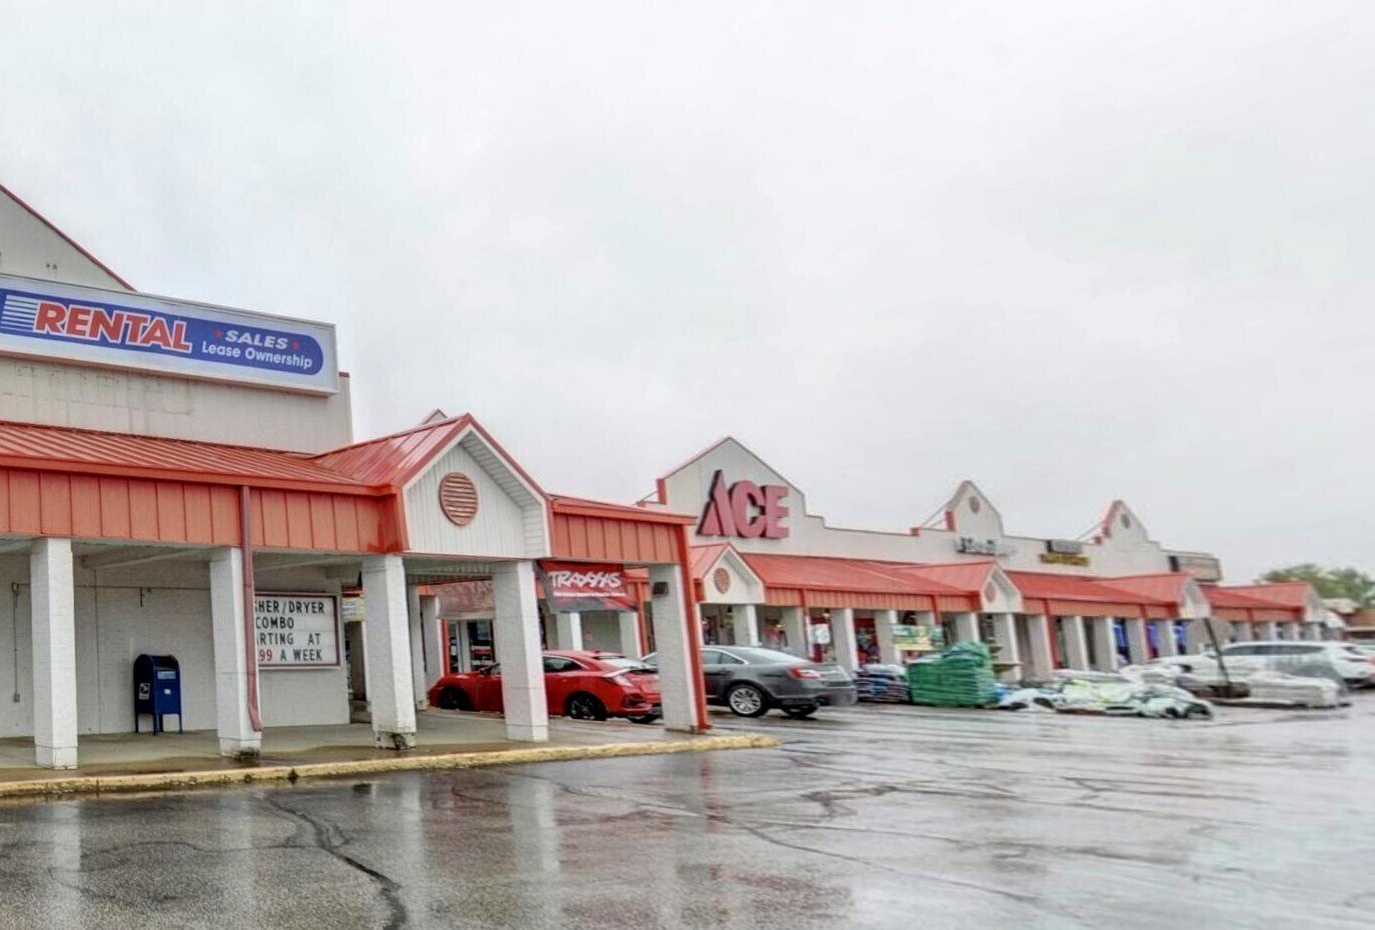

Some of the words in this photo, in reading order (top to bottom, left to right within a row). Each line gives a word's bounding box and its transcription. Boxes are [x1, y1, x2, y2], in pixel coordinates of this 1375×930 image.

[33, 302, 192, 354] RENTAL
[224, 328, 289, 351] SALES
[201, 339, 241, 360] Lease
[244, 348, 313, 370] Ownership
[695, 469, 790, 540] ACE
[547, 570, 623, 589] TRAXXAS
[255, 616, 294, 629] COMBO
[256, 632, 294, 645] RTING
[307, 632, 322, 645] AT
[279, 648, 287, 661] A
[292, 648, 323, 662] WEEK
